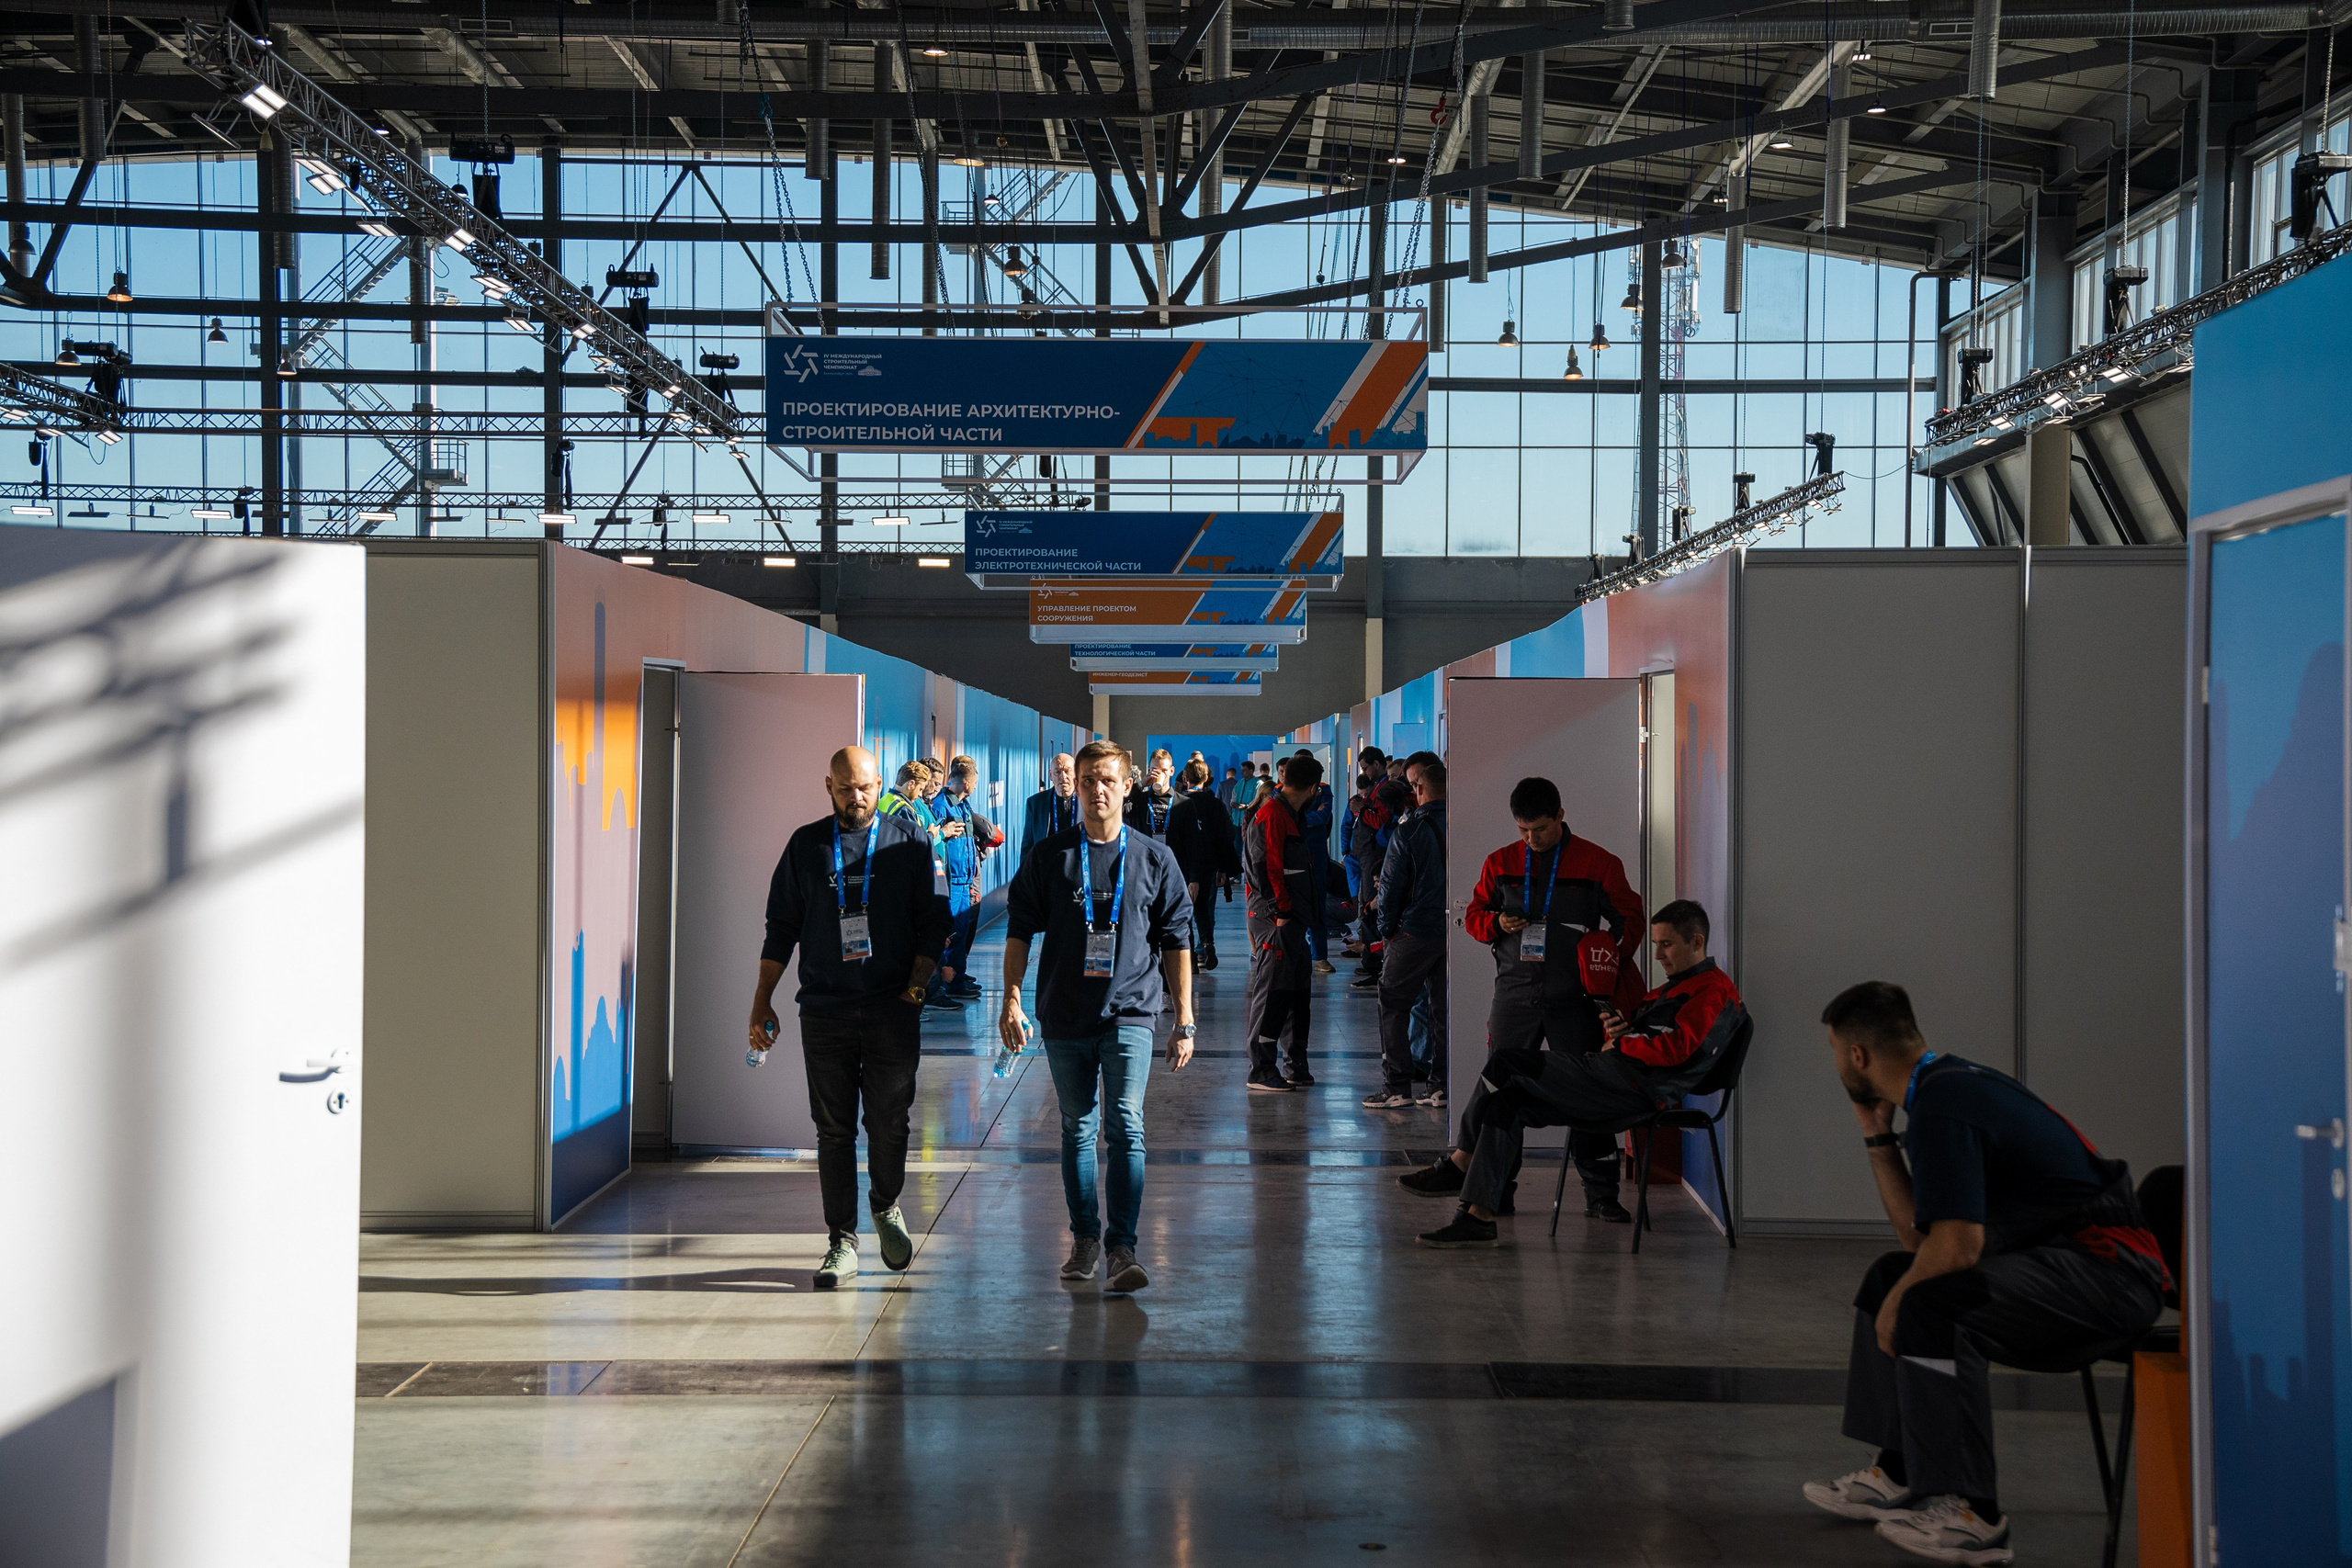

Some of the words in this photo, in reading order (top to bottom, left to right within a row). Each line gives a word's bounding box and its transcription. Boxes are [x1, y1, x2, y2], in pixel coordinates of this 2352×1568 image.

[783, 402, 962, 417] ПРОЕКТИРОВАНИЕ
[967, 404, 1121, 419] АРХИТЕКТУРНО-
[782, 423, 935, 440] СТРОИТЕЛЬНОЙ
[940, 427, 1002, 441] ЧАСТИ
[975, 548, 1079, 557] ПРОЕКТИРОВАНИЕ
[975, 560, 1102, 570] ЭЛЕКТРОТЕХНИЧЕСКОЙ
[1105, 562, 1142, 570] ЧАСТИ
